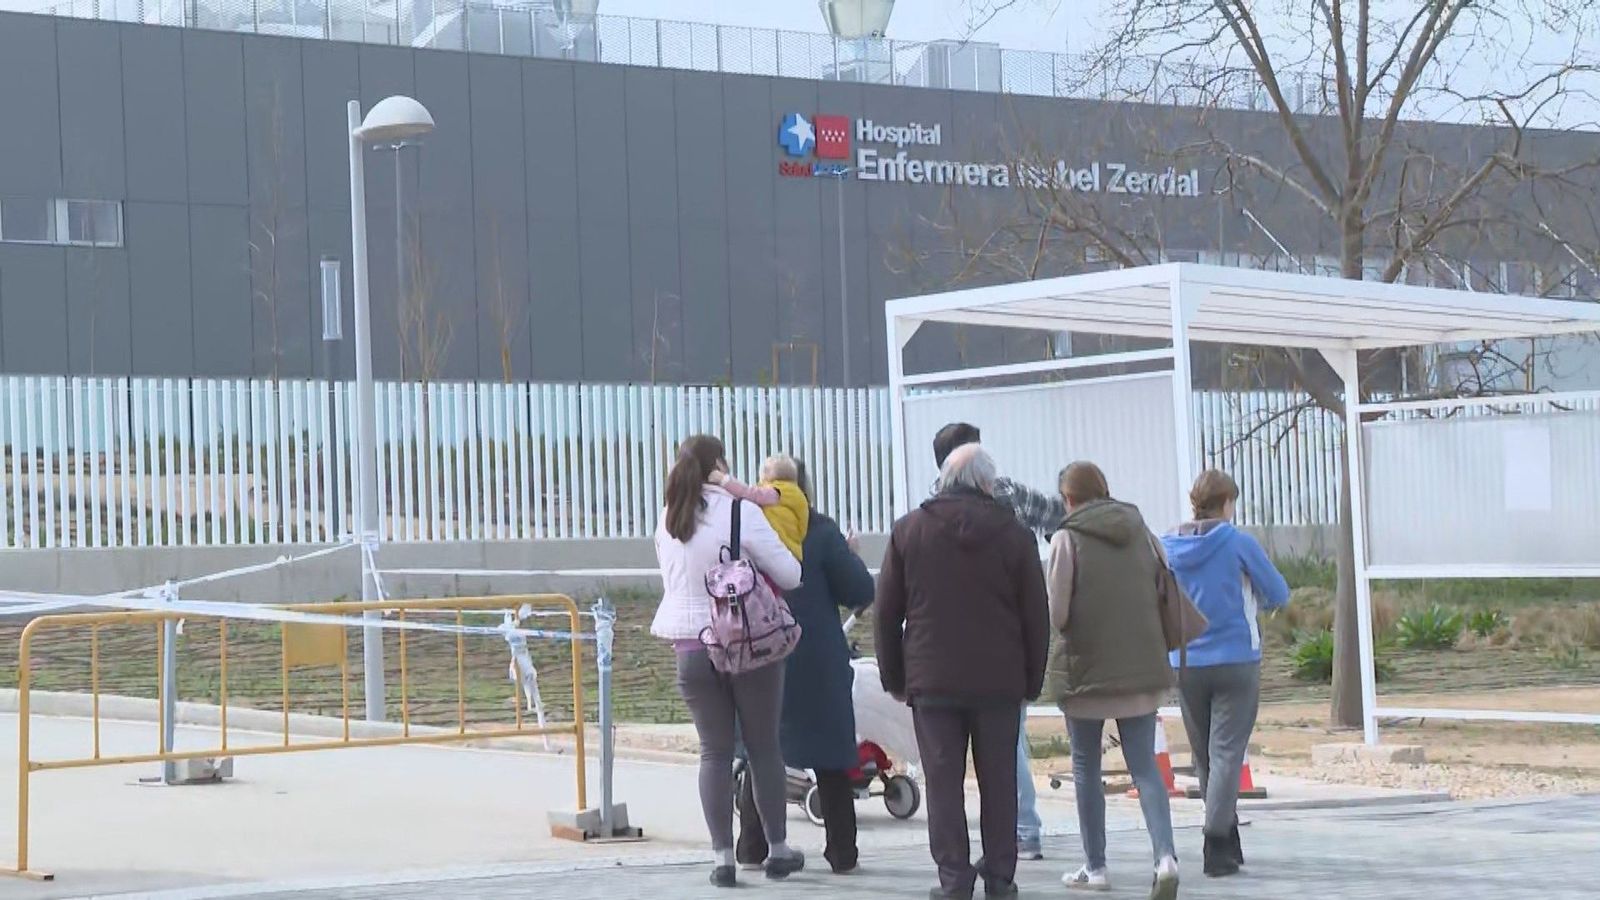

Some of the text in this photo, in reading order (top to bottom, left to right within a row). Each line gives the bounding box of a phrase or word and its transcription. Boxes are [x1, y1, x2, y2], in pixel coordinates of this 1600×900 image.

[856, 118, 941, 148] Hospital
[856, 148, 1009, 187] Enfermera
[1106, 163, 1199, 197] Zendal
